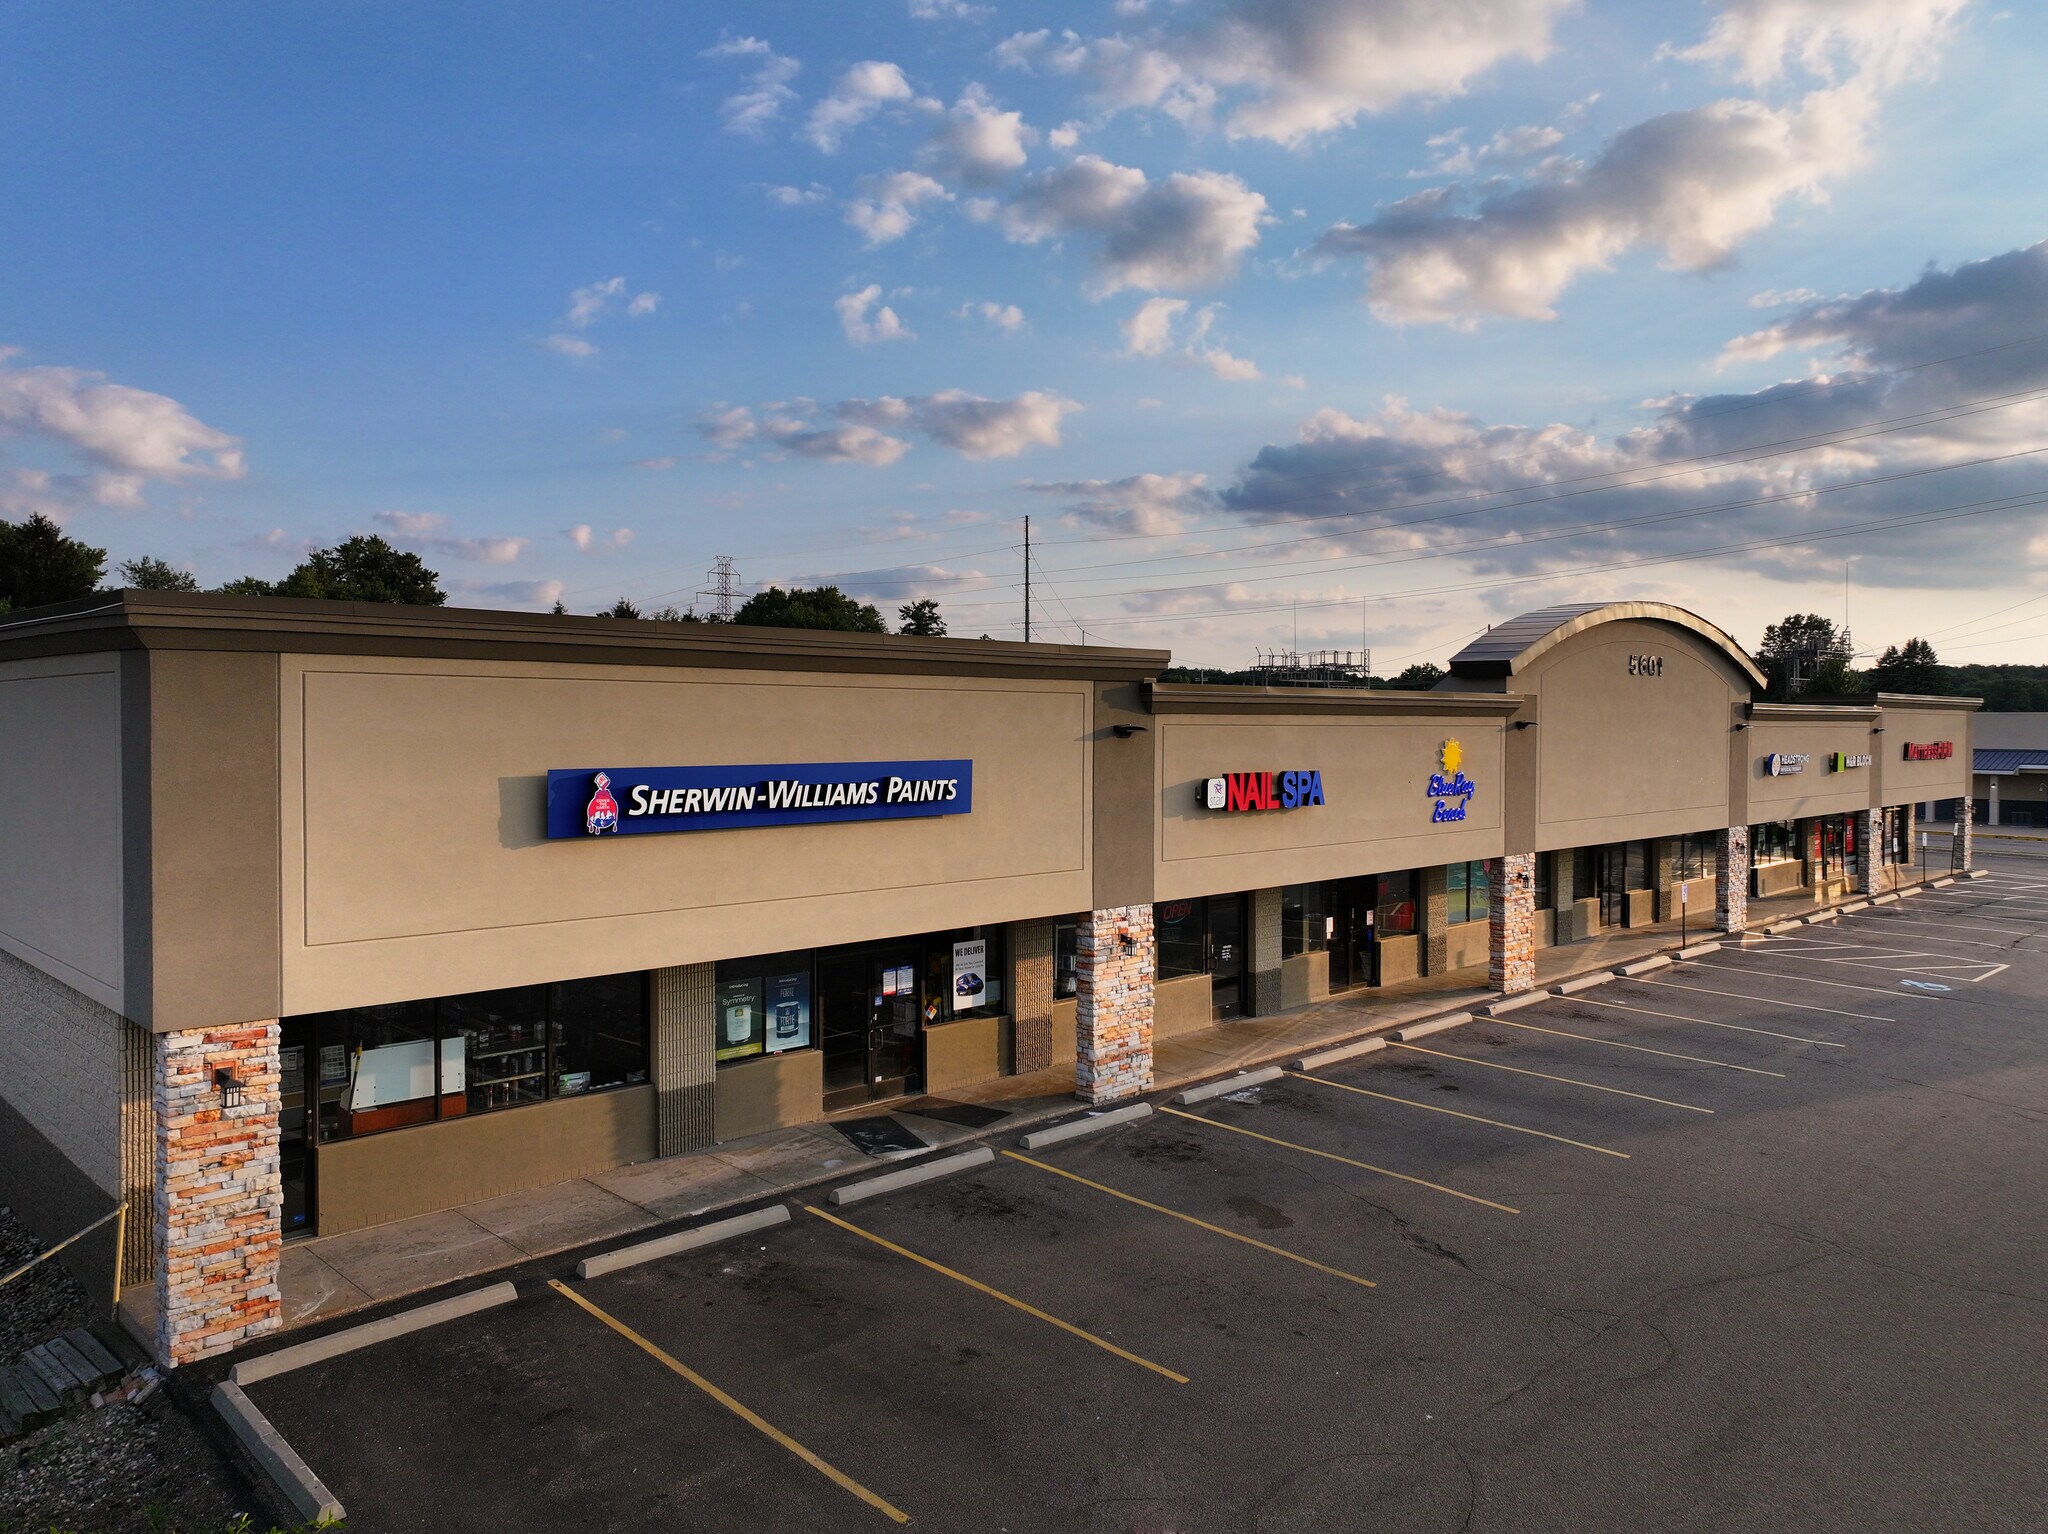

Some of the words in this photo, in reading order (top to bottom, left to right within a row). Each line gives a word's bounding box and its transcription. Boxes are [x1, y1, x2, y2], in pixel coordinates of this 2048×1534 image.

[1628, 654, 1663, 676] 5601
[1857, 755, 1872, 767] BLOCK
[628, 780, 879, 816] SHERWIN-WILLIAMS
[886, 776, 958, 803] PAINTS
[1227, 771, 1280, 812] NAIL
[1282, 770, 1325, 809] SPA
[1163, 902, 1192, 920] OPEN
[955, 948, 963, 957] WE
[964, 945, 984, 956] DELIVER
[722, 995, 756, 1006] Symmetry
[780, 1015, 795, 1026] FORTE
